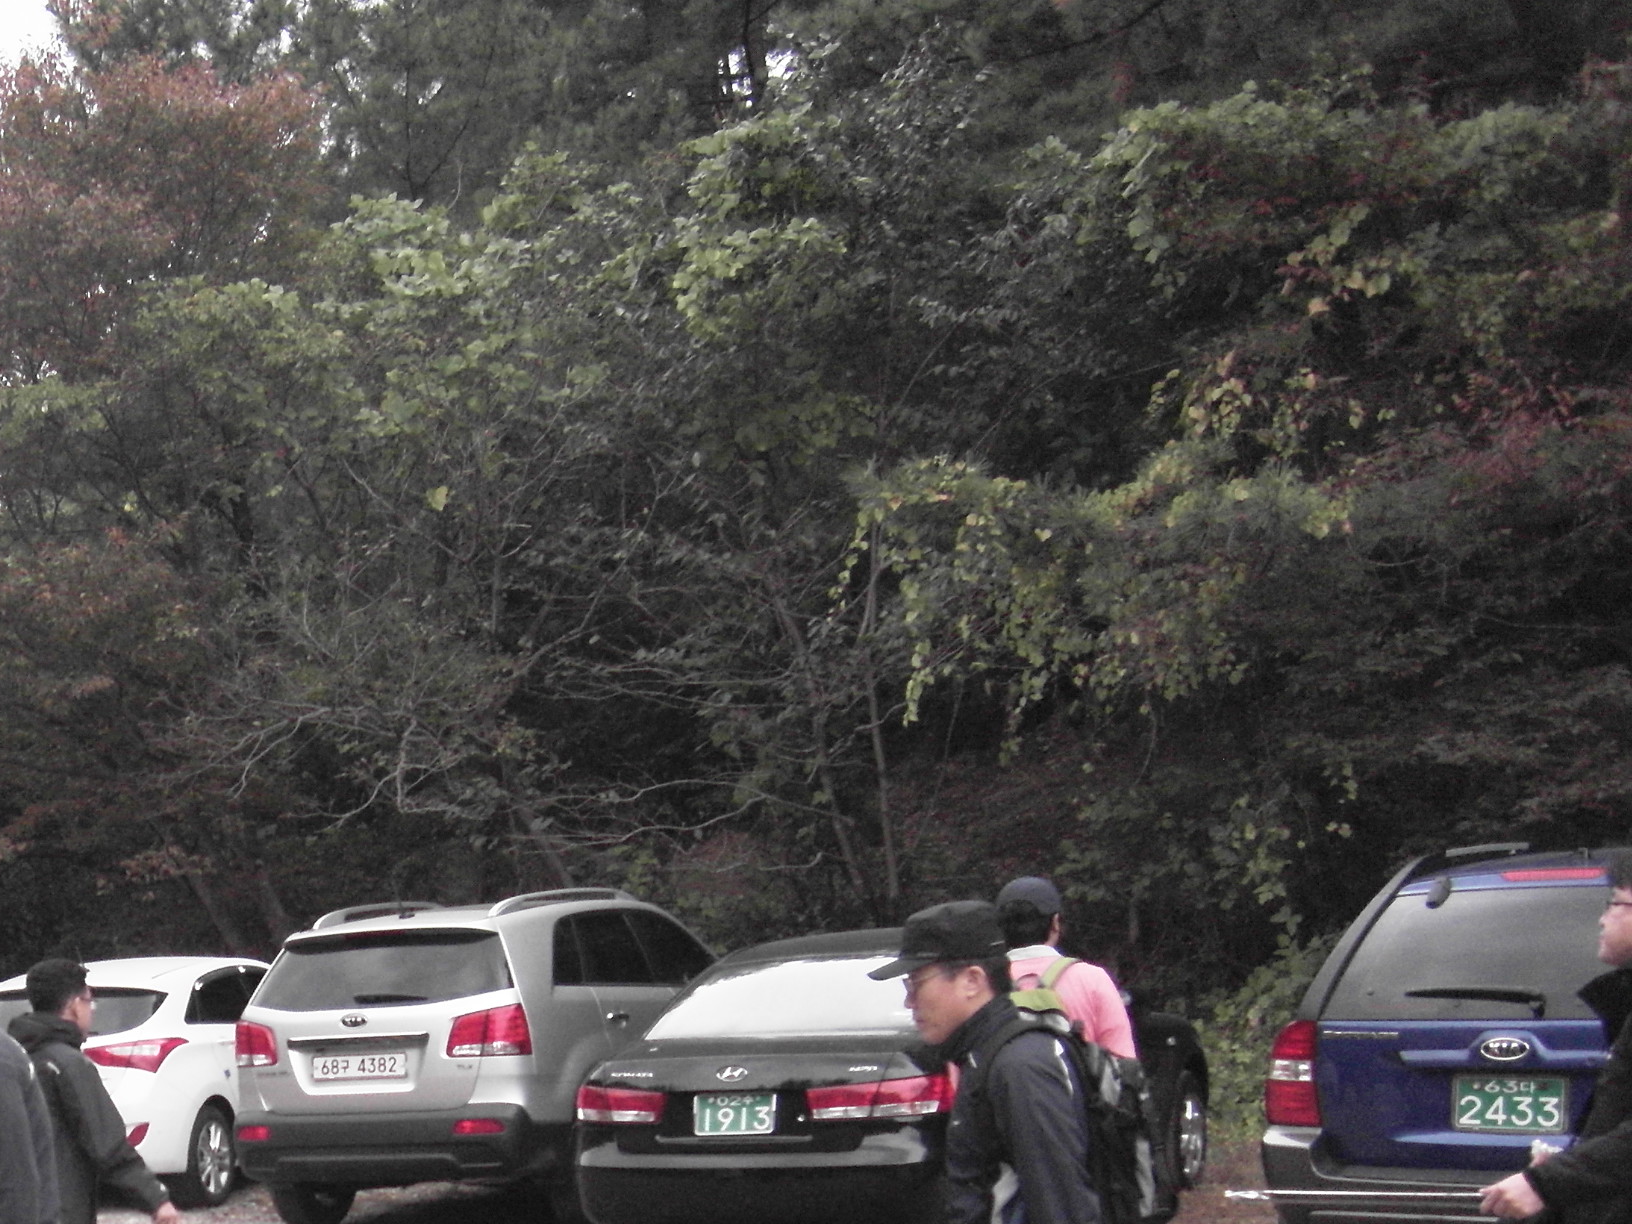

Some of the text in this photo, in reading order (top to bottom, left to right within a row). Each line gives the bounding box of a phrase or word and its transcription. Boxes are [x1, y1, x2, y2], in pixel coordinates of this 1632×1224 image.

[321, 1056, 397, 1076] 68구 4382
[704, 1106, 770, 1131] 1913
[1459, 1095, 1560, 1127] 2433
